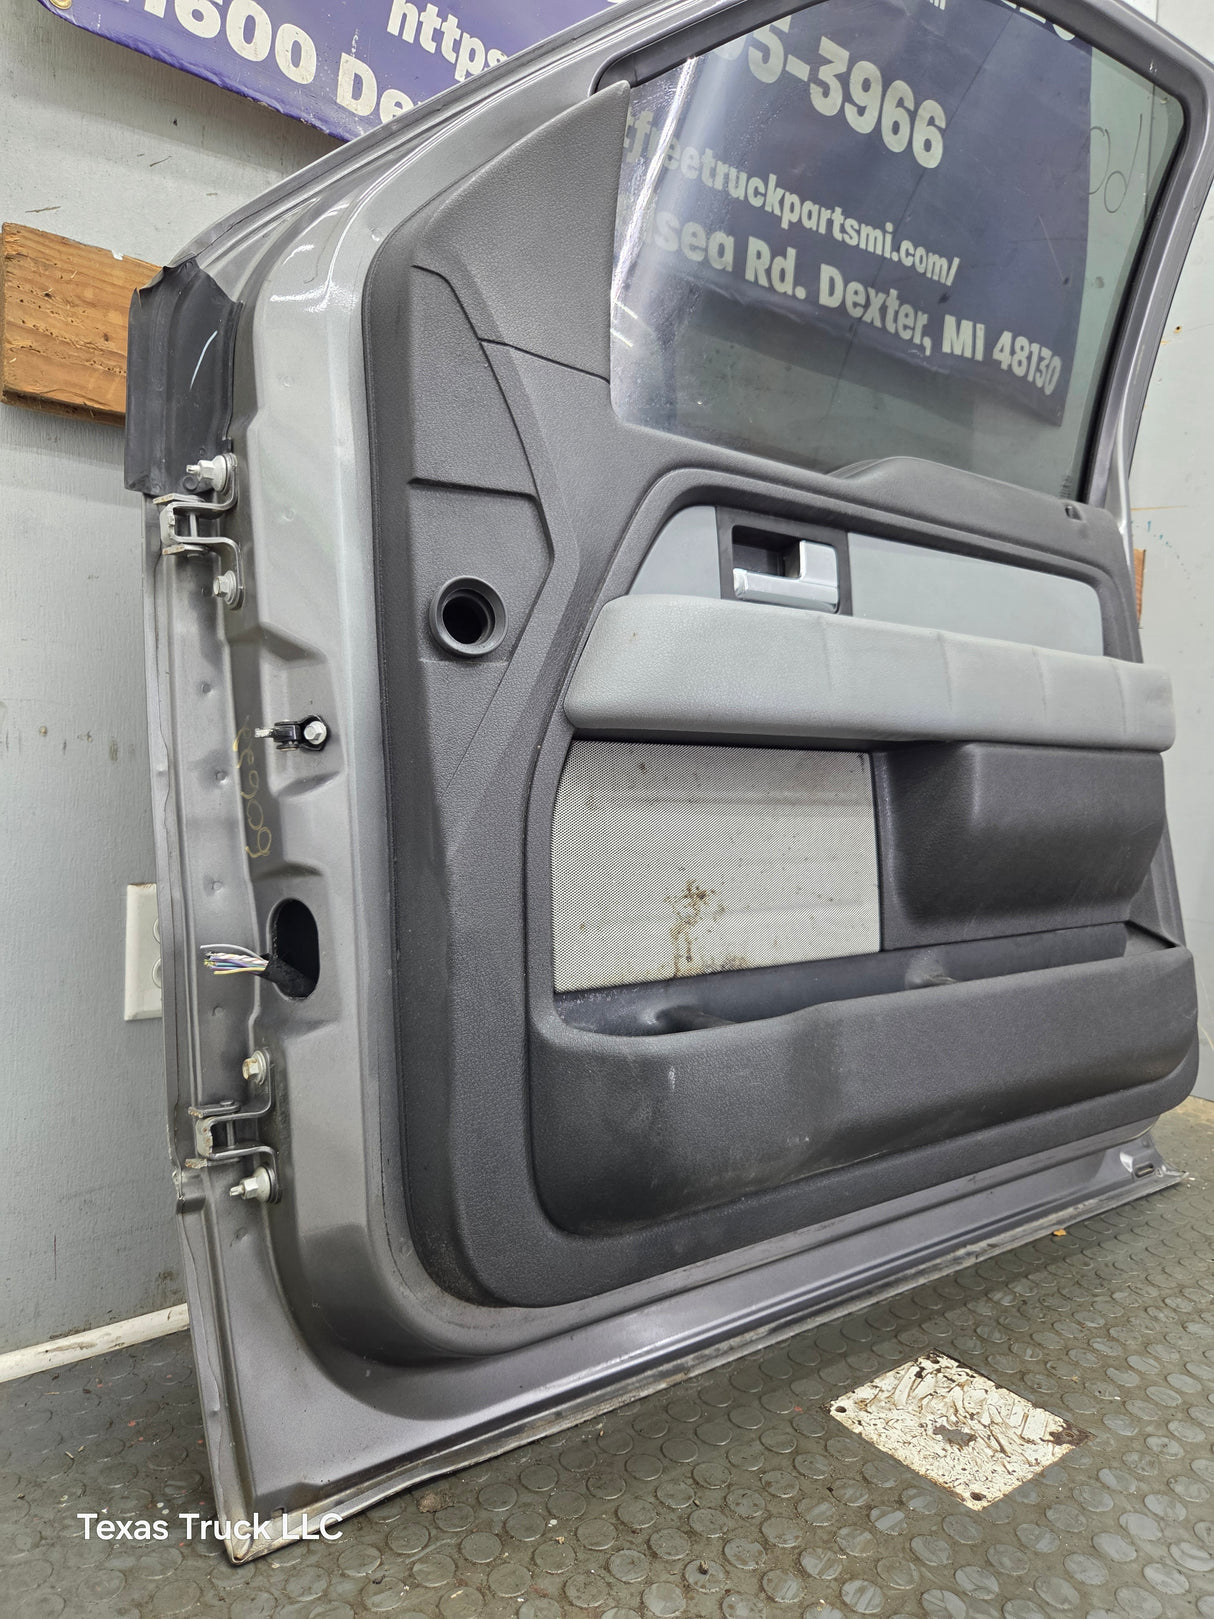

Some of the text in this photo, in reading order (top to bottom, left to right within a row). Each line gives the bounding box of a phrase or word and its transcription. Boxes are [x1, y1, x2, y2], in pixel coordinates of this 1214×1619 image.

[336, 52, 422, 124] De
[745, 235, 807, 300] Rd.
[819, 263, 933, 357] Dexter,
[942, 314, 986, 362] MI
[992, 330, 1062, 396] 48130
